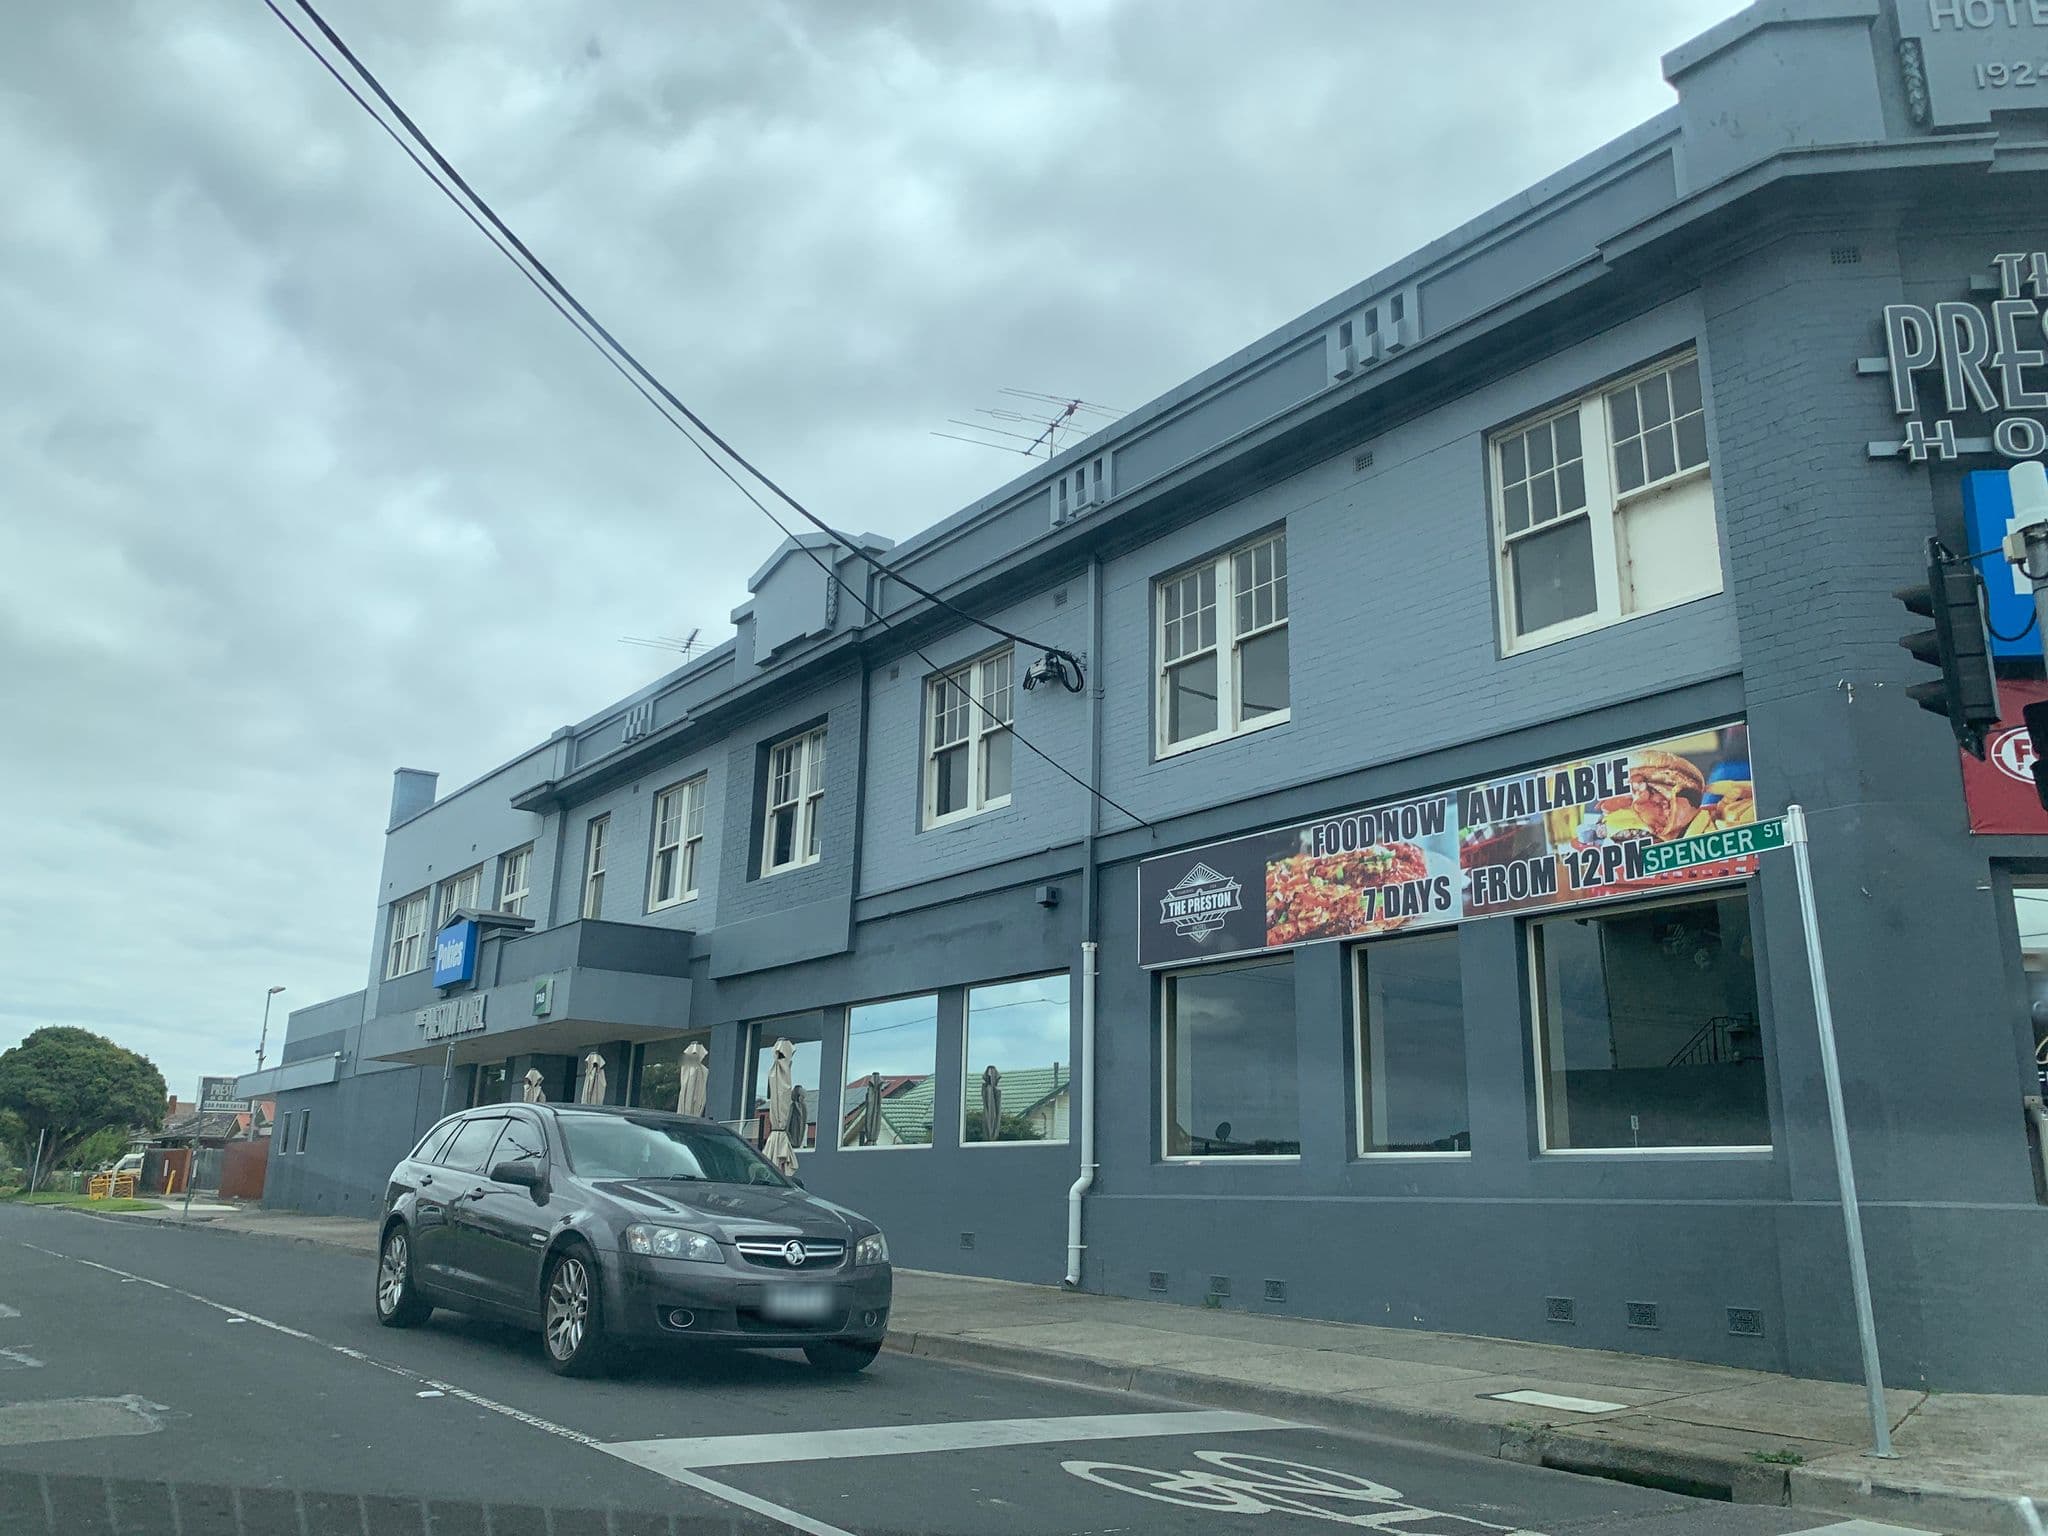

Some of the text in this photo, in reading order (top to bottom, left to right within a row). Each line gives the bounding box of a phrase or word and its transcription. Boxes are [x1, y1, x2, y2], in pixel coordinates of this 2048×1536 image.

[1882, 300, 2048, 414] PRE
[1311, 755, 1633, 858] FOOD NOW AVAILABLE
[1645, 821, 1782, 873] SPENCER ST
[1169, 891, 1231, 917] THE PRESTON
[1362, 837, 1654, 923] 7 DAYS FROM 12PM
